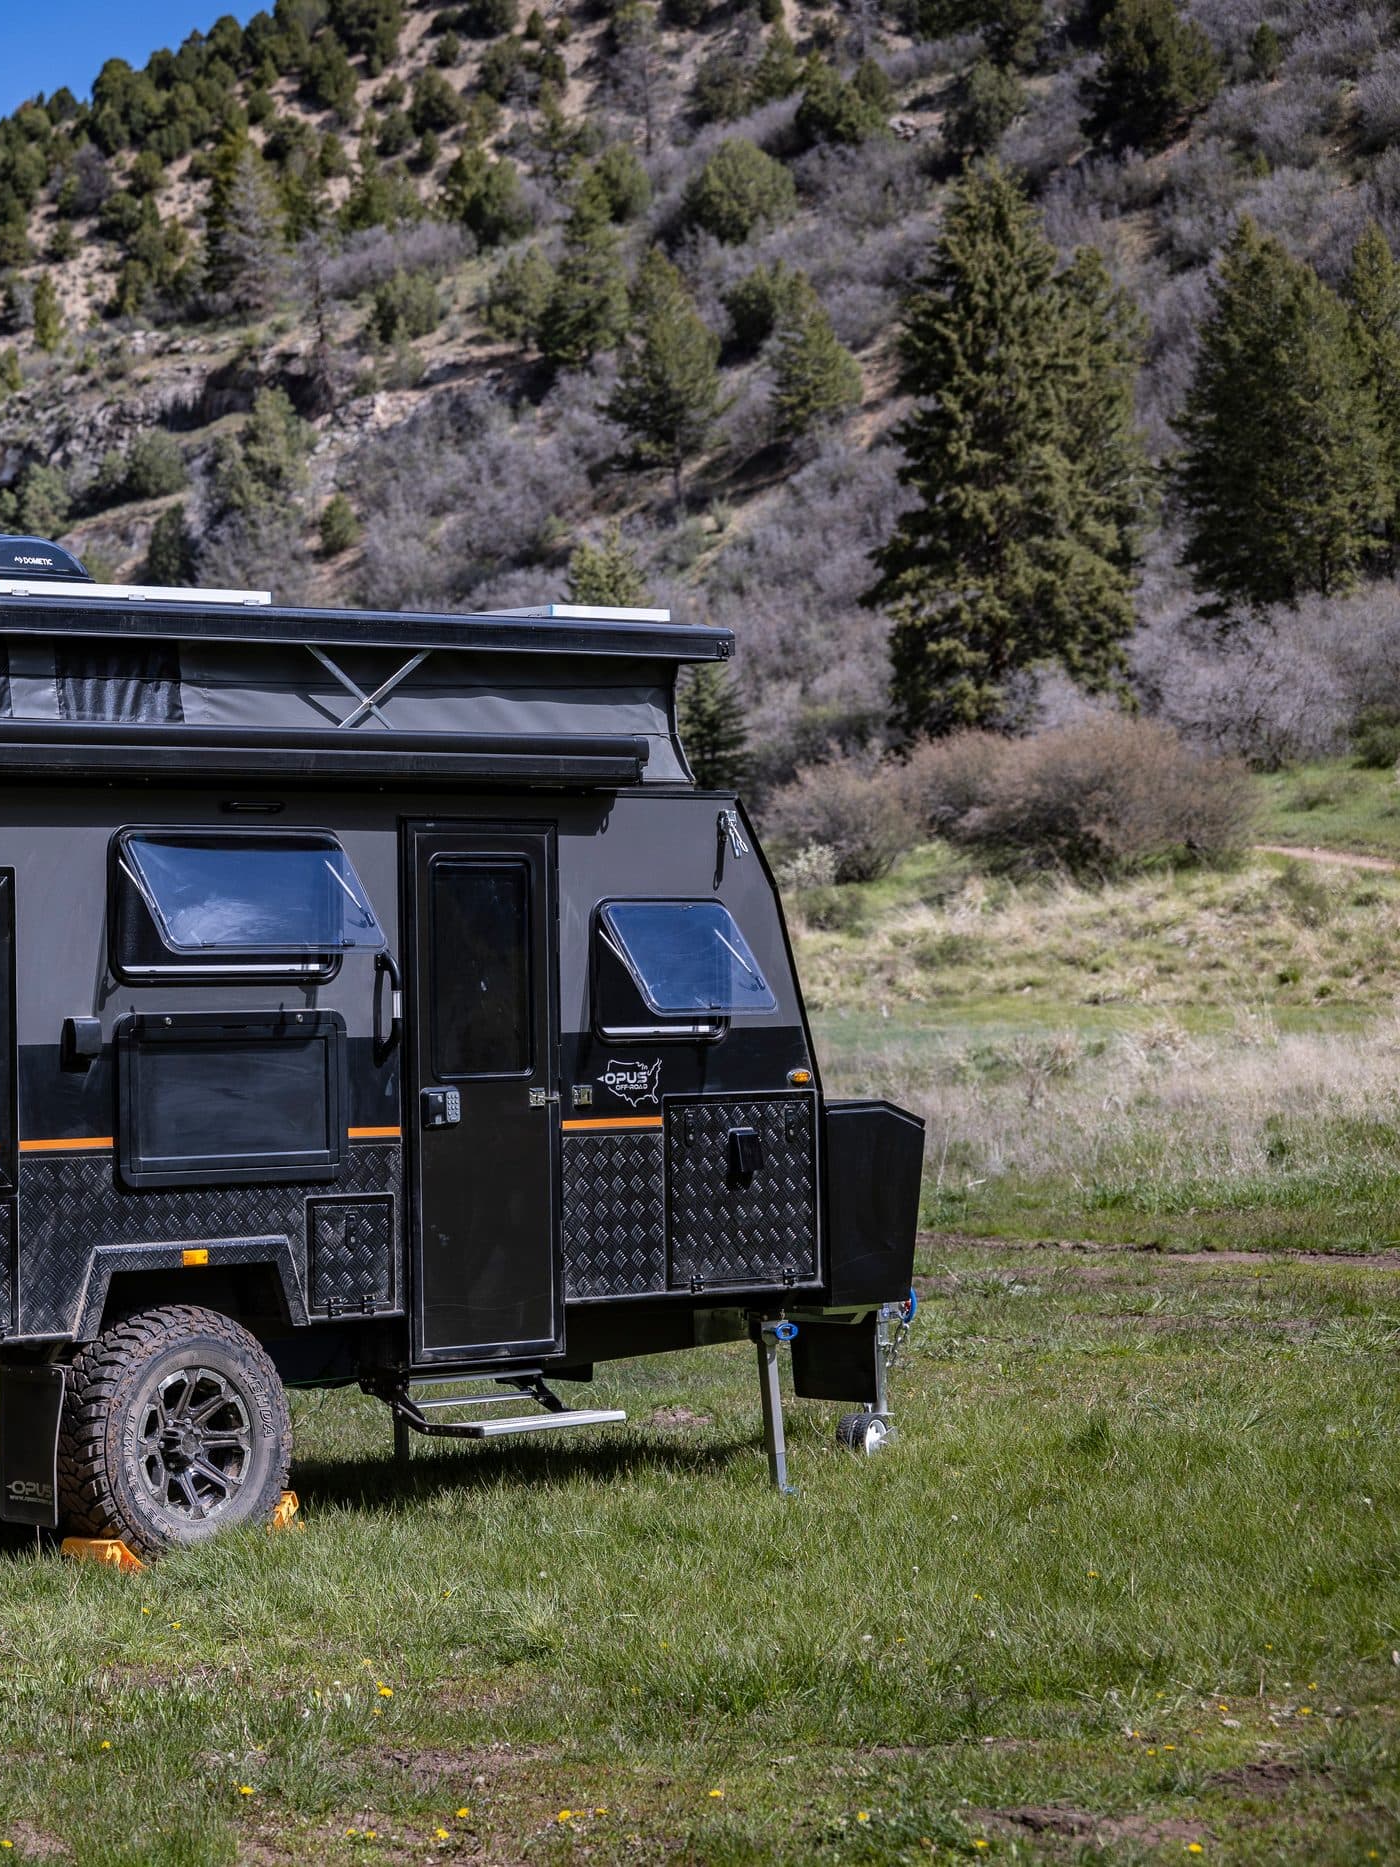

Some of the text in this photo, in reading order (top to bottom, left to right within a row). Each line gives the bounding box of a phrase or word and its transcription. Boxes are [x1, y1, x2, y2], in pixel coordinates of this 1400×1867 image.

[23, 556, 53, 566] DOMETIC
[605, 1071, 648, 1085] OPUS
[615, 1083, 648, 1091] OFF-ROAD
[240, 1366, 276, 1439] KENDA
